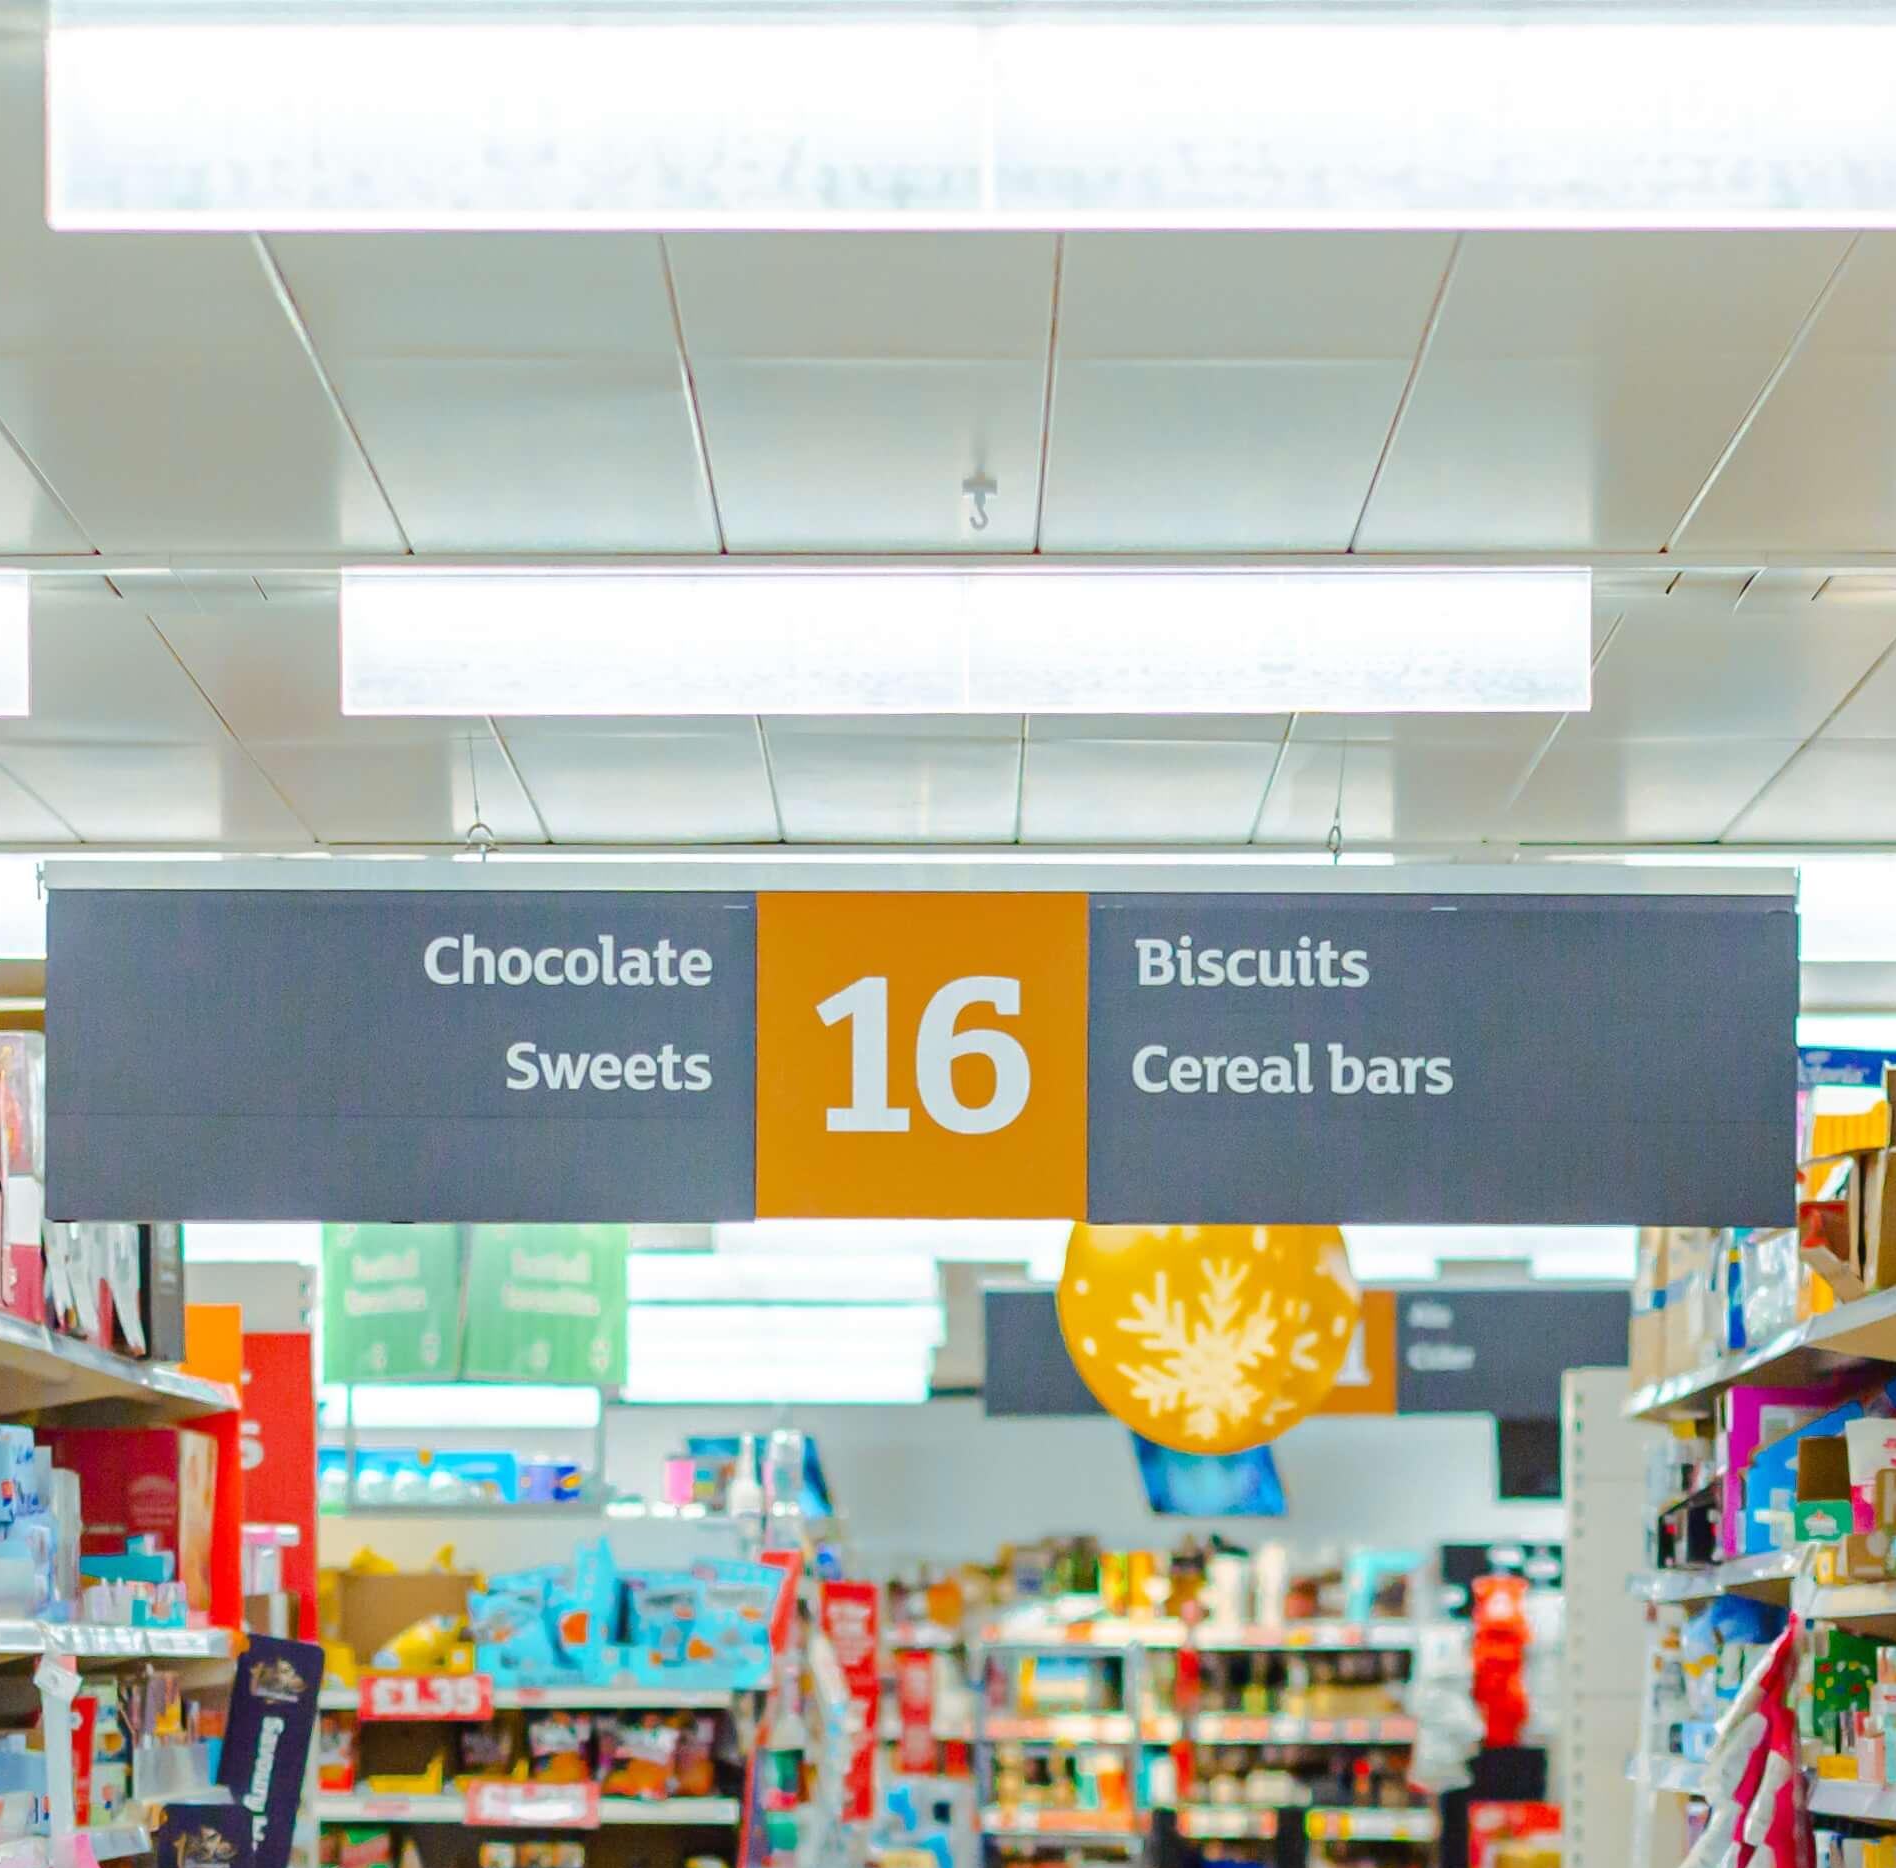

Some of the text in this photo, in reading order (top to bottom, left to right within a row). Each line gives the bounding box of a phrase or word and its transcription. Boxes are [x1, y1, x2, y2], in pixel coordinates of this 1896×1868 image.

[422, 935, 713, 988] Chocolate
[1136, 937, 1371, 989] Biscuits
[505, 1041, 713, 1092] Sweets
[814, 975, 1032, 1135] 16
[1131, 1043, 1454, 1097] Cereal bars
